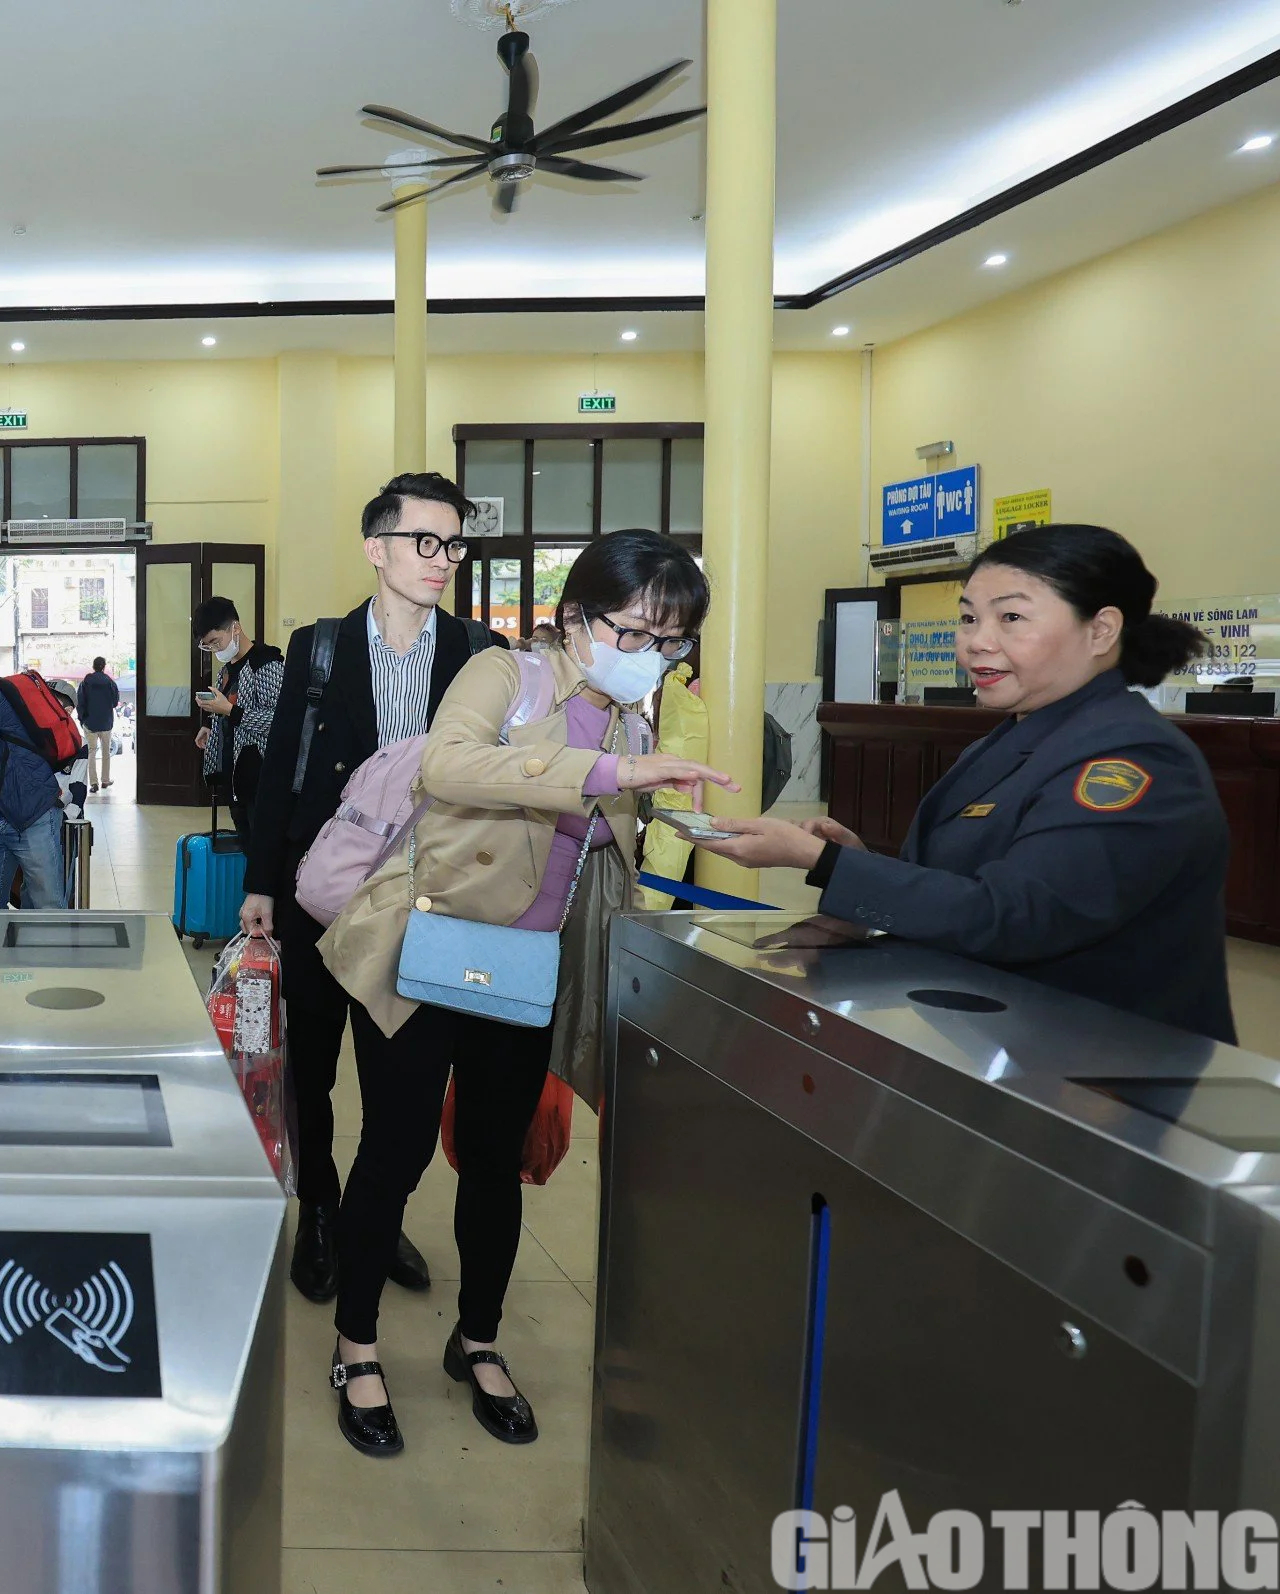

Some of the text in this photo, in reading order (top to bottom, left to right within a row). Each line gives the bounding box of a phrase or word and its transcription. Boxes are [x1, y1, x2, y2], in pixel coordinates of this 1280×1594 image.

[583, 398, 614, 409] EXIT
[887, 487, 907, 505] PHÒNG
[920, 481, 932, 499] TÀU
[945, 490, 962, 512] WC
[996, 505, 1022, 515] LUGGAGE
[1023, 500, 1048, 510] LOCKER
[888, 502, 929, 517] WAITING ROOM
[1207, 608, 1234, 621] SÔNG
[1236, 608, 1258, 620] LAM
[1220, 624, 1250, 638] VINH
[1233, 644, 1257, 658] 122
[1233, 662, 1257, 675] 122
